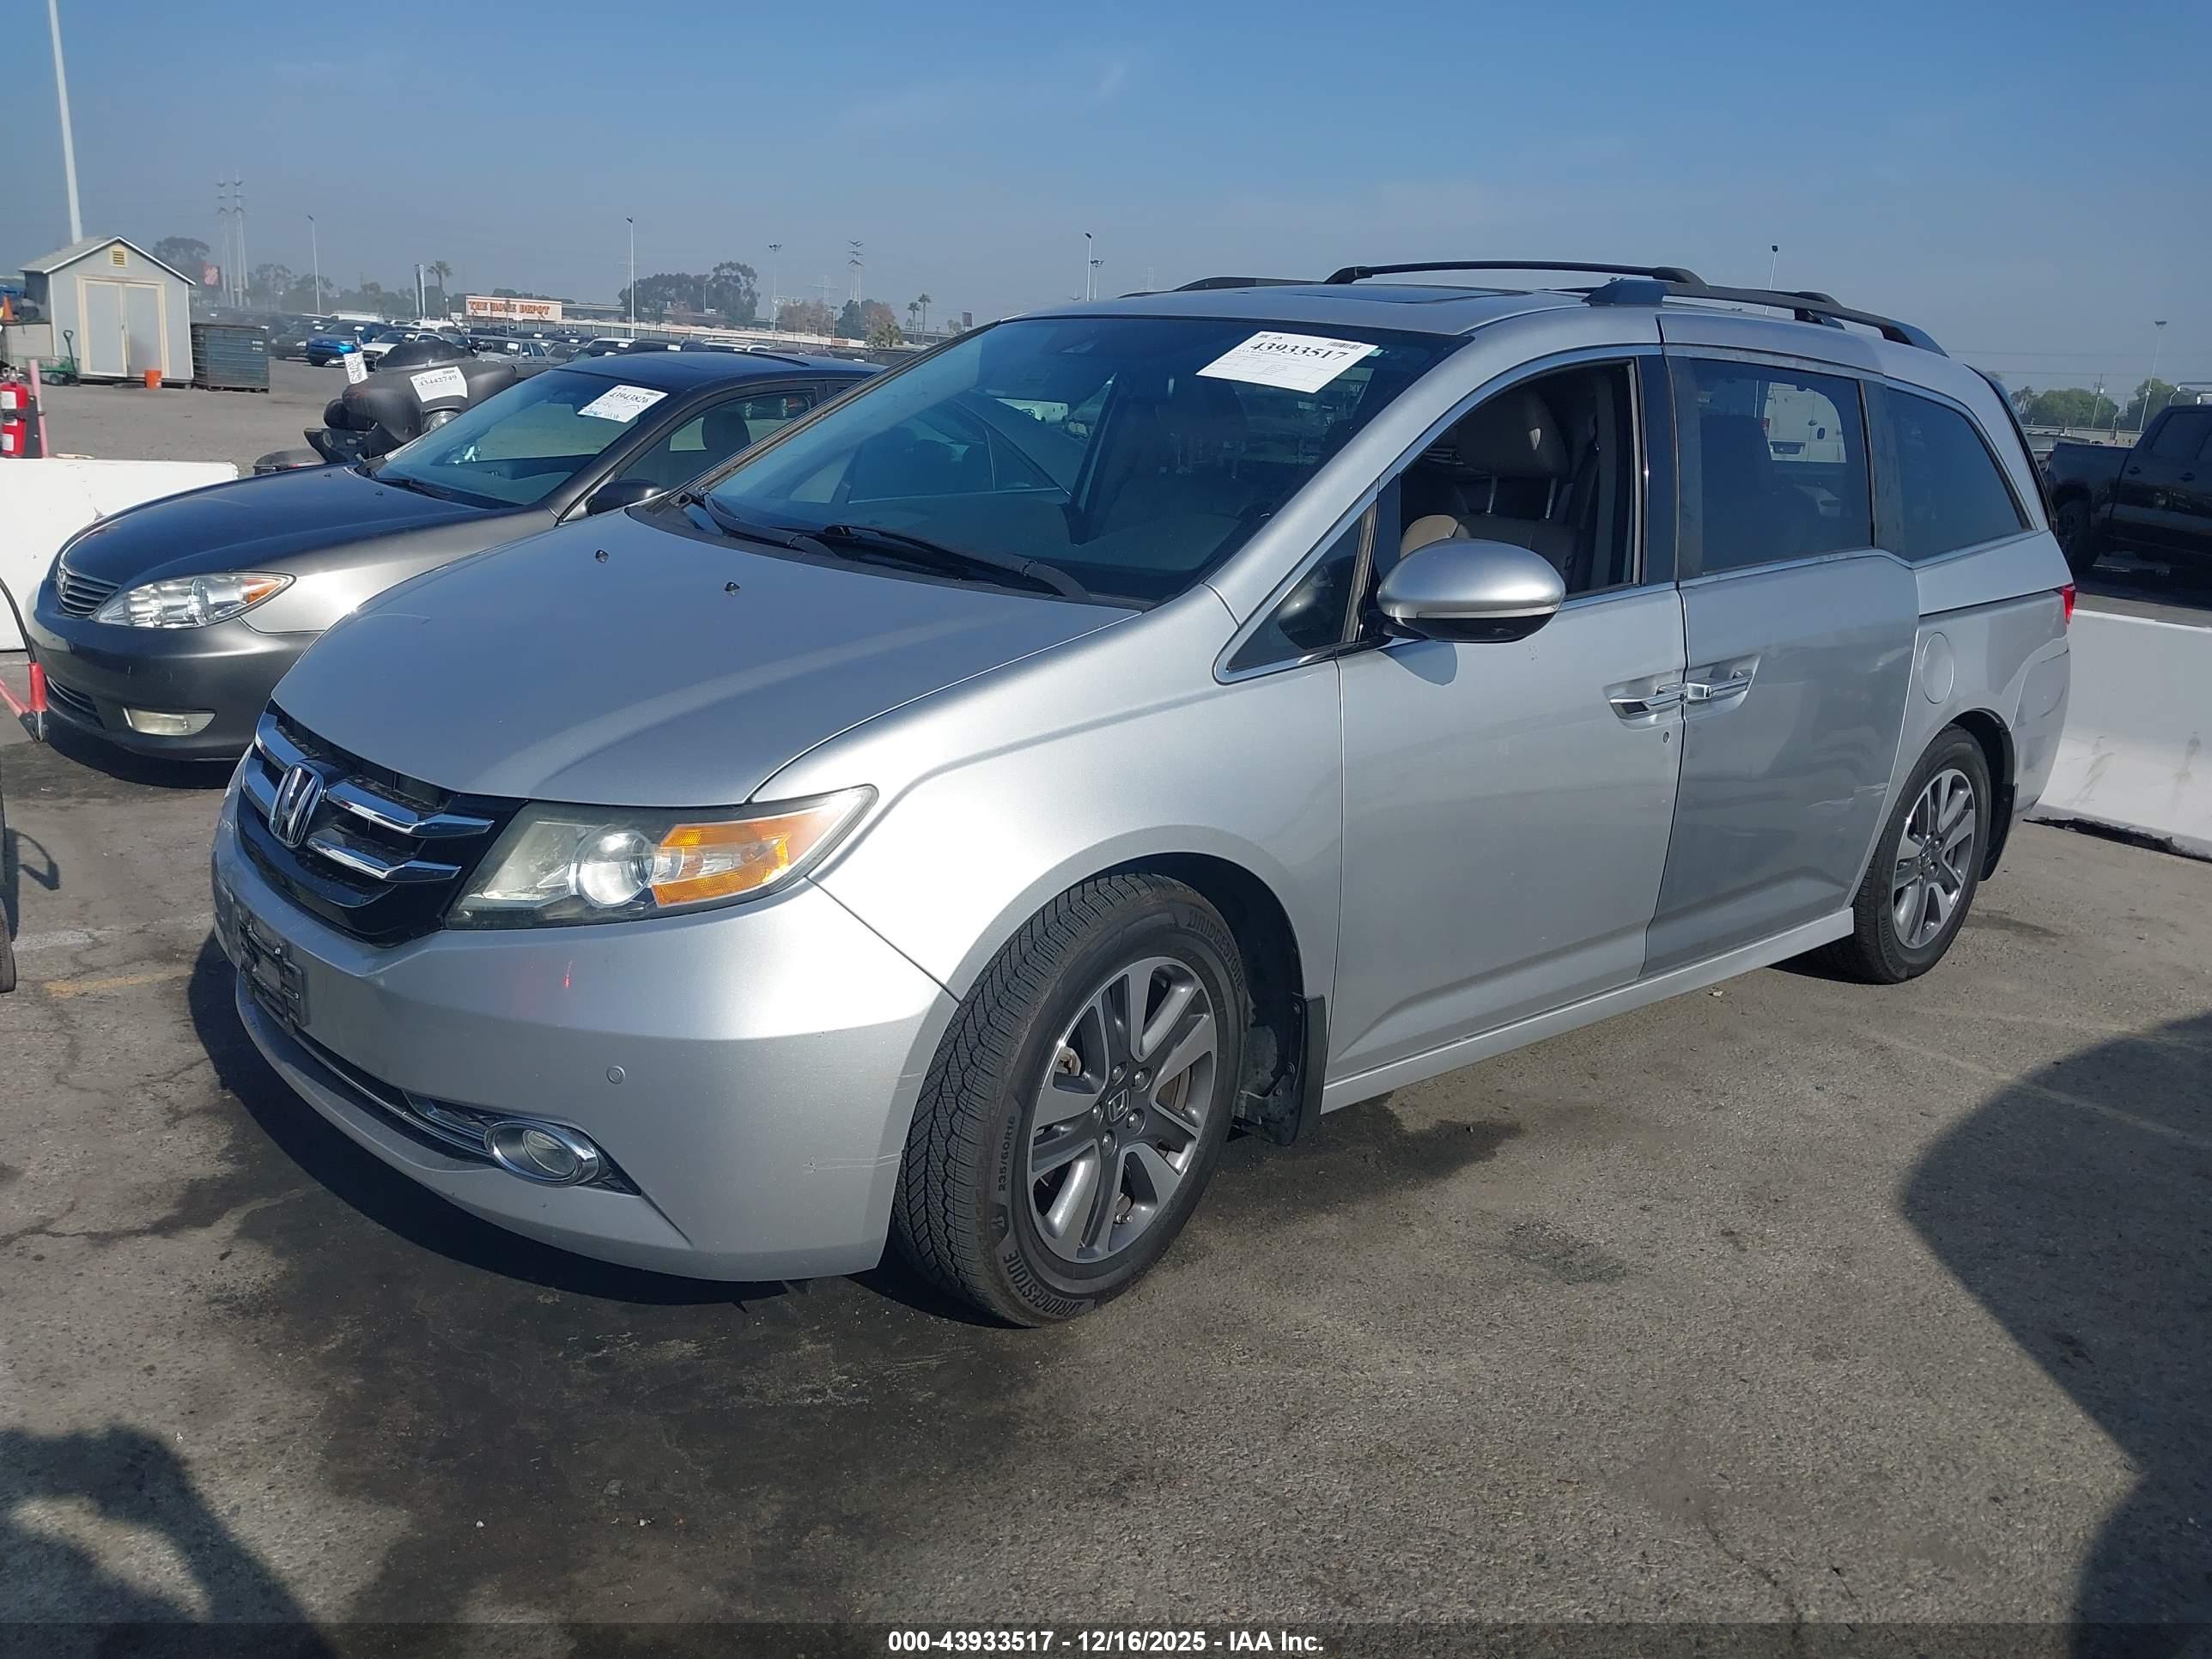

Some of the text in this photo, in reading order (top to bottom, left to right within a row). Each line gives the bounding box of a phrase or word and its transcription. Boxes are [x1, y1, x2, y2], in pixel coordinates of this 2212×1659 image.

[468, 301, 488, 311] THE
[520, 304, 550, 314] DEPOT
[1250, 343, 1349, 361] 43933517
[1003, 1250, 1084, 1317] BRIDGESTONE
